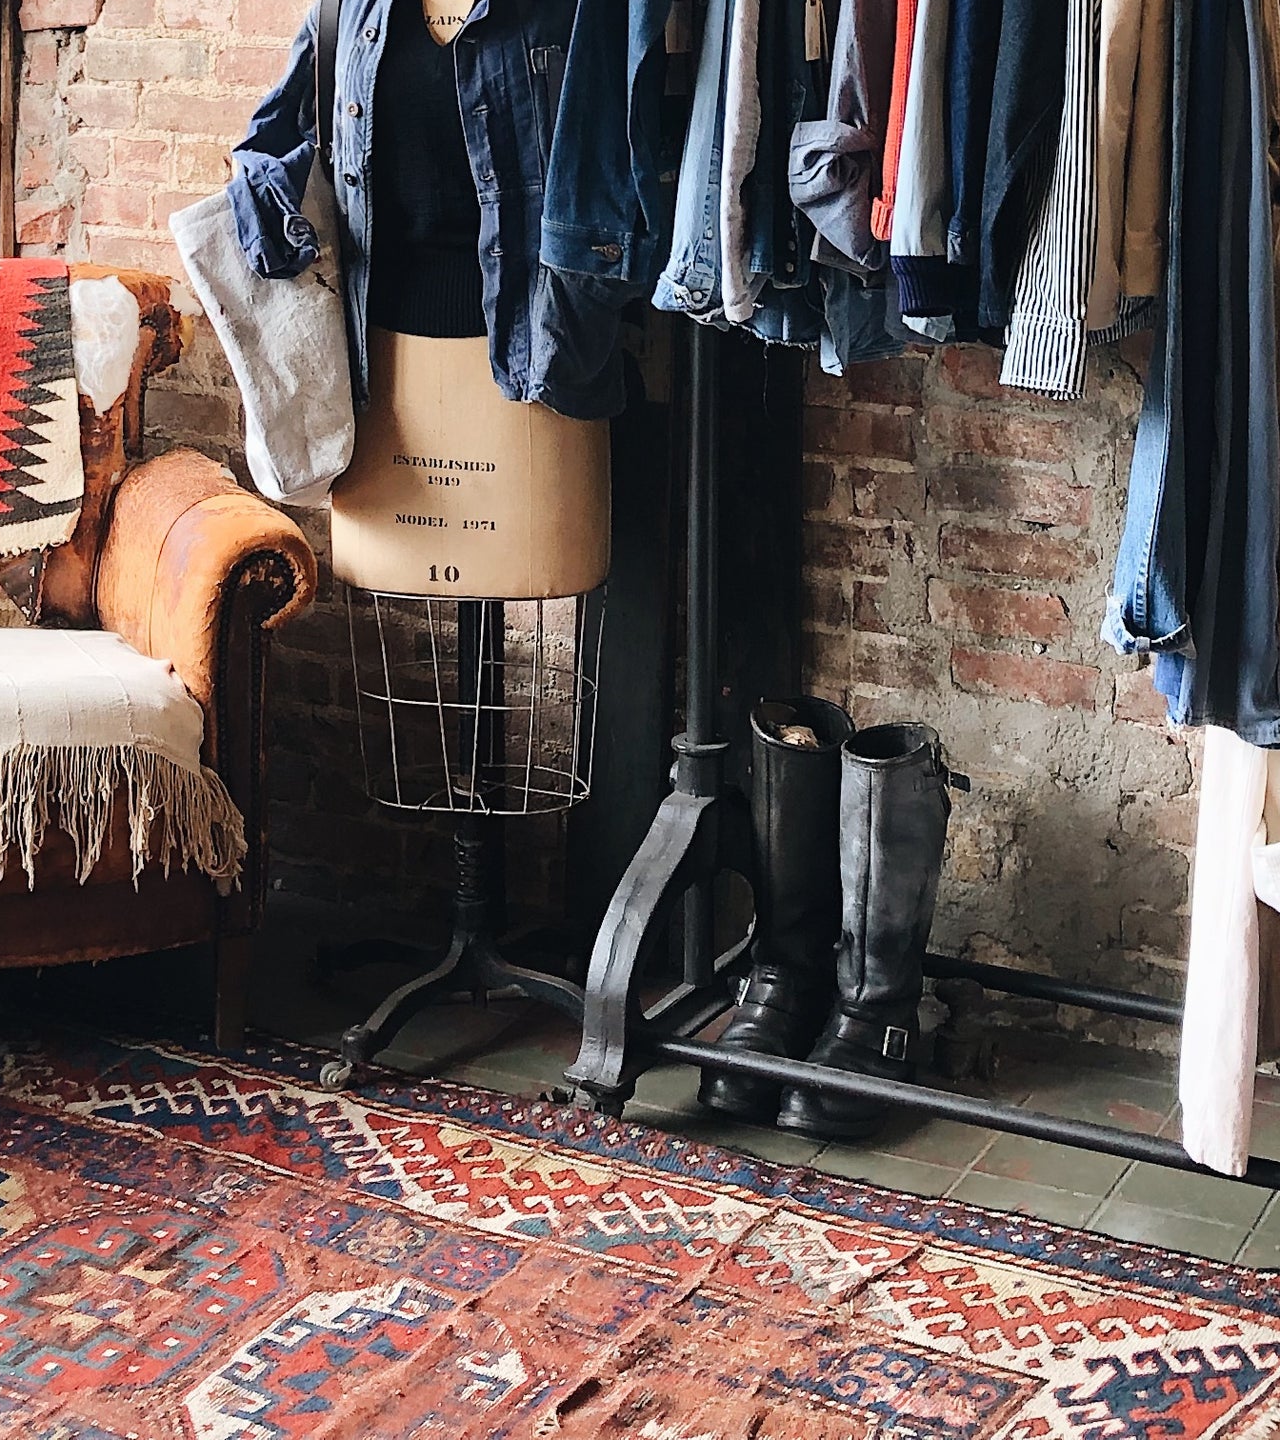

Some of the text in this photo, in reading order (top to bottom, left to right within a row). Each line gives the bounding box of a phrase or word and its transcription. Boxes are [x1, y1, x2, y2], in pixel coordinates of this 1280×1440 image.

[426, 15, 466, 26] LAPS
[392, 454, 497, 473] ESTABLISHED
[427, 475, 460, 487] 1919
[395, 513, 496, 531] MODEL 1971
[428, 564, 460, 583] 10
